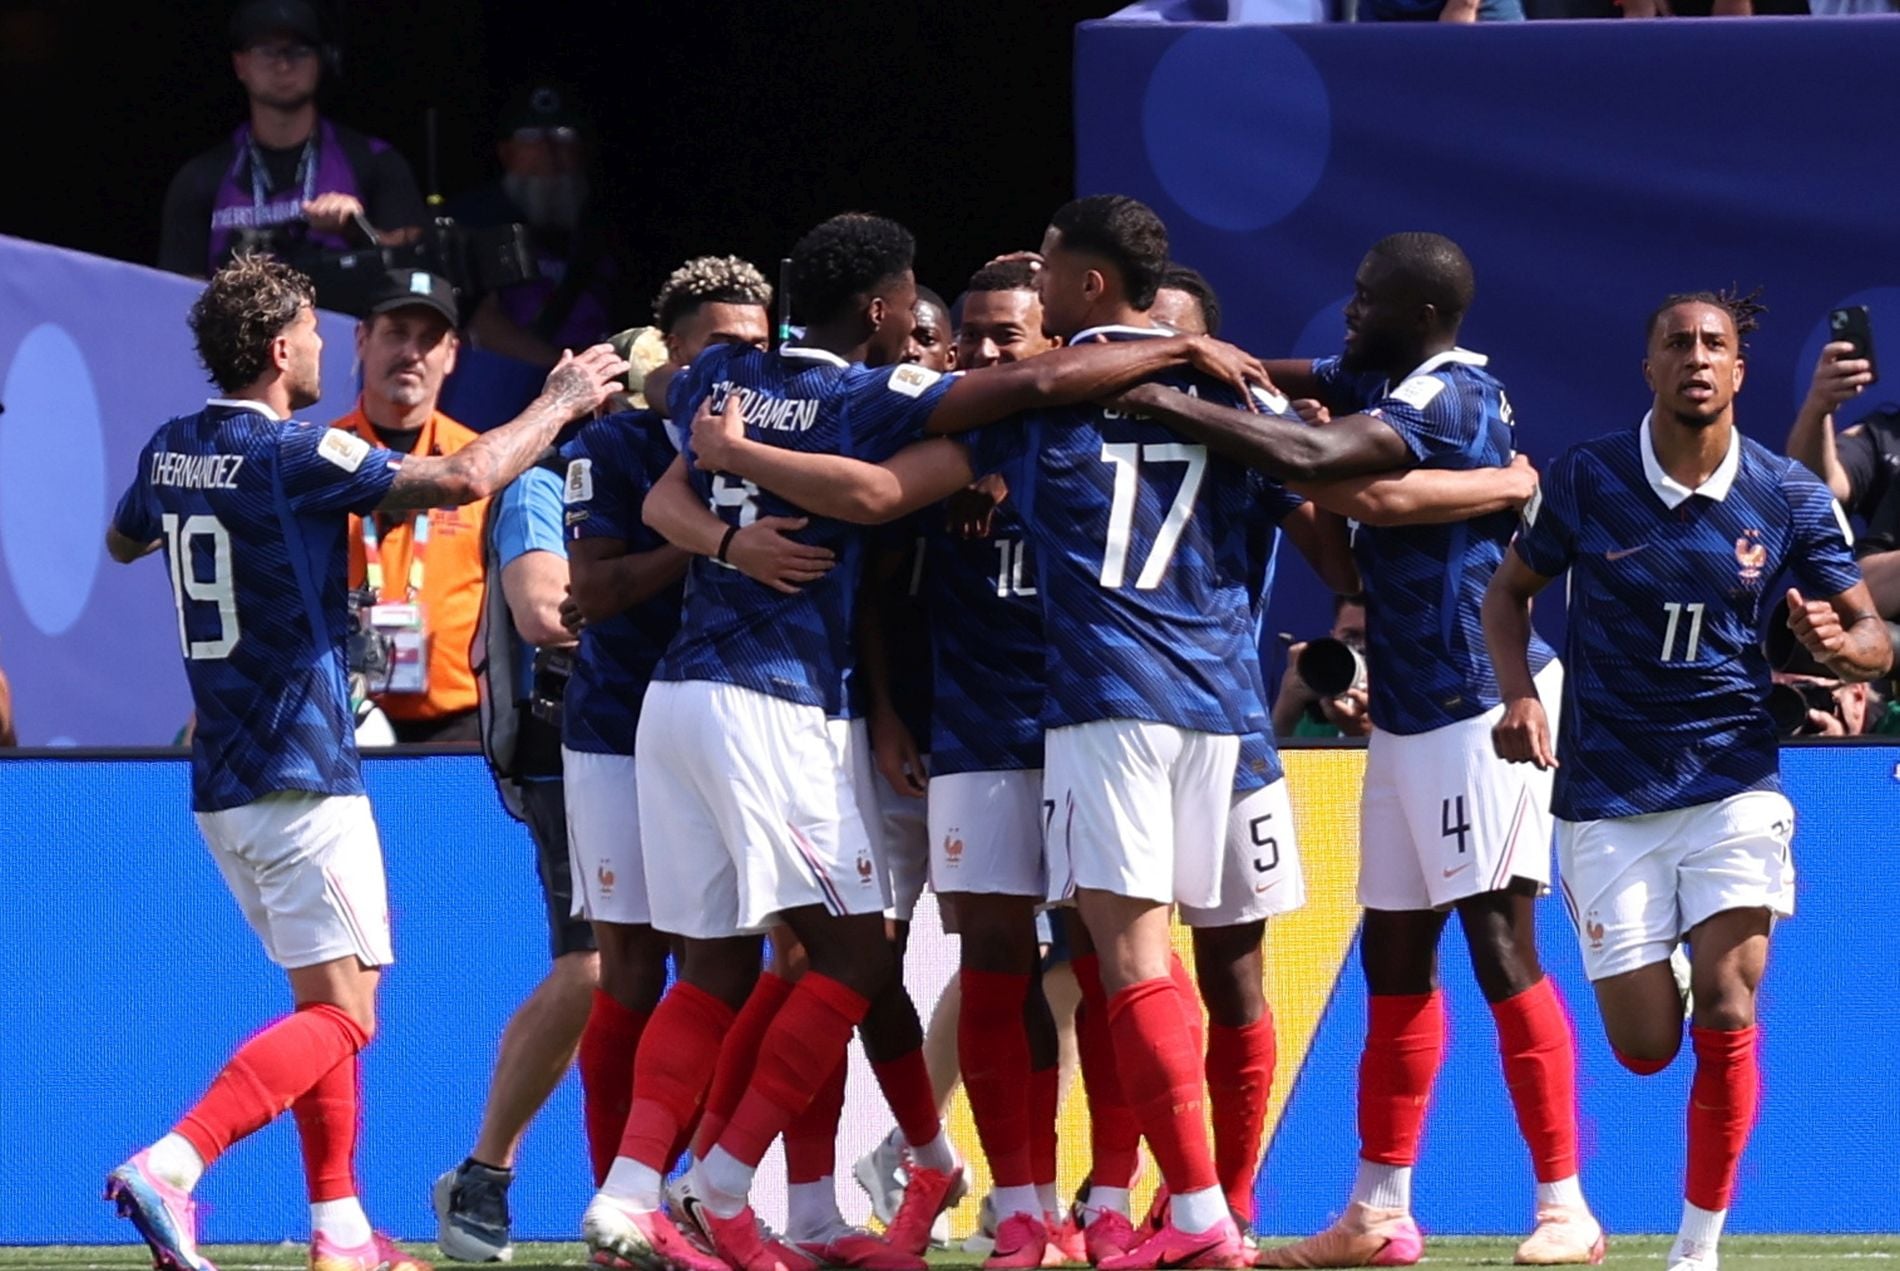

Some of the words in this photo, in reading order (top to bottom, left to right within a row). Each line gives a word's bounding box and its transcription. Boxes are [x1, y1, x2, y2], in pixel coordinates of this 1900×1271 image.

[1100, 442, 1208, 589] 17
[161, 513, 241, 660] 19
[1660, 602, 1705, 662] 11
[1250, 813, 1279, 873] 5
[1441, 795, 1470, 853] 4
